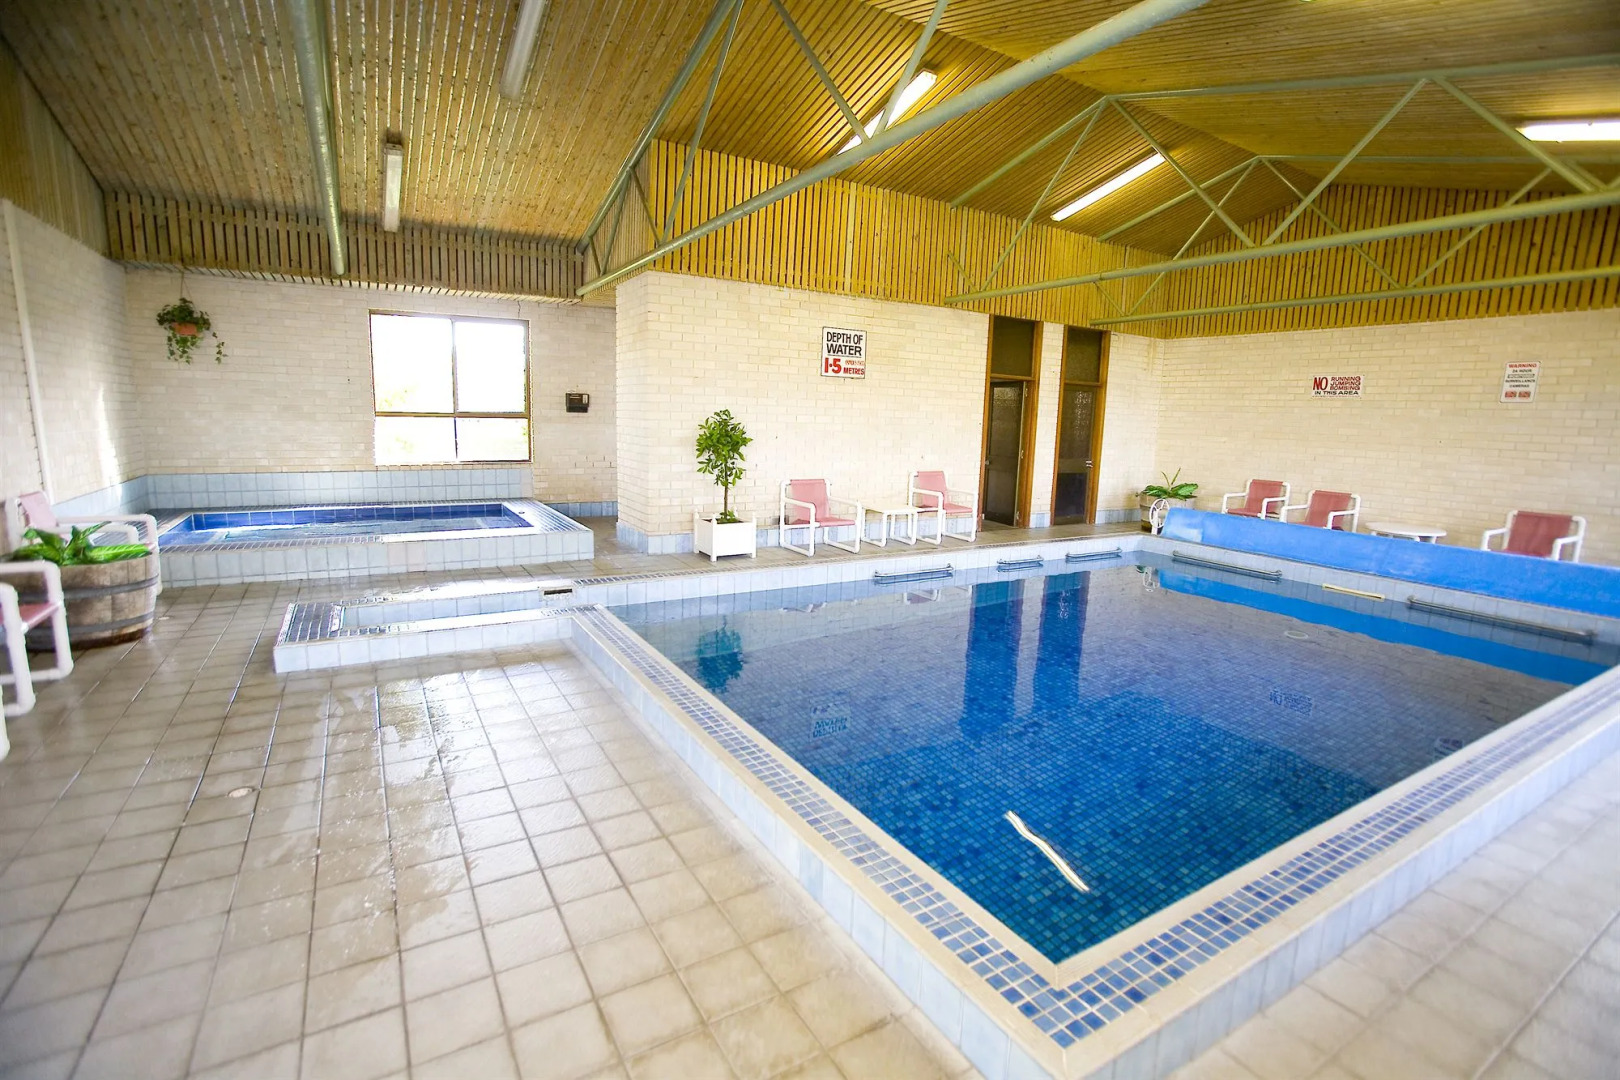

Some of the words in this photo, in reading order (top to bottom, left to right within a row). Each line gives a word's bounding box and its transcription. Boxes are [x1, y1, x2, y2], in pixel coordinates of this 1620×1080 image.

[826, 331, 852, 344] DEPTH
[852, 334, 863, 345] OF
[826, 343, 862, 356] WATER
[843, 367, 865, 375] METRES
[1312, 376, 1328, 390] NO
